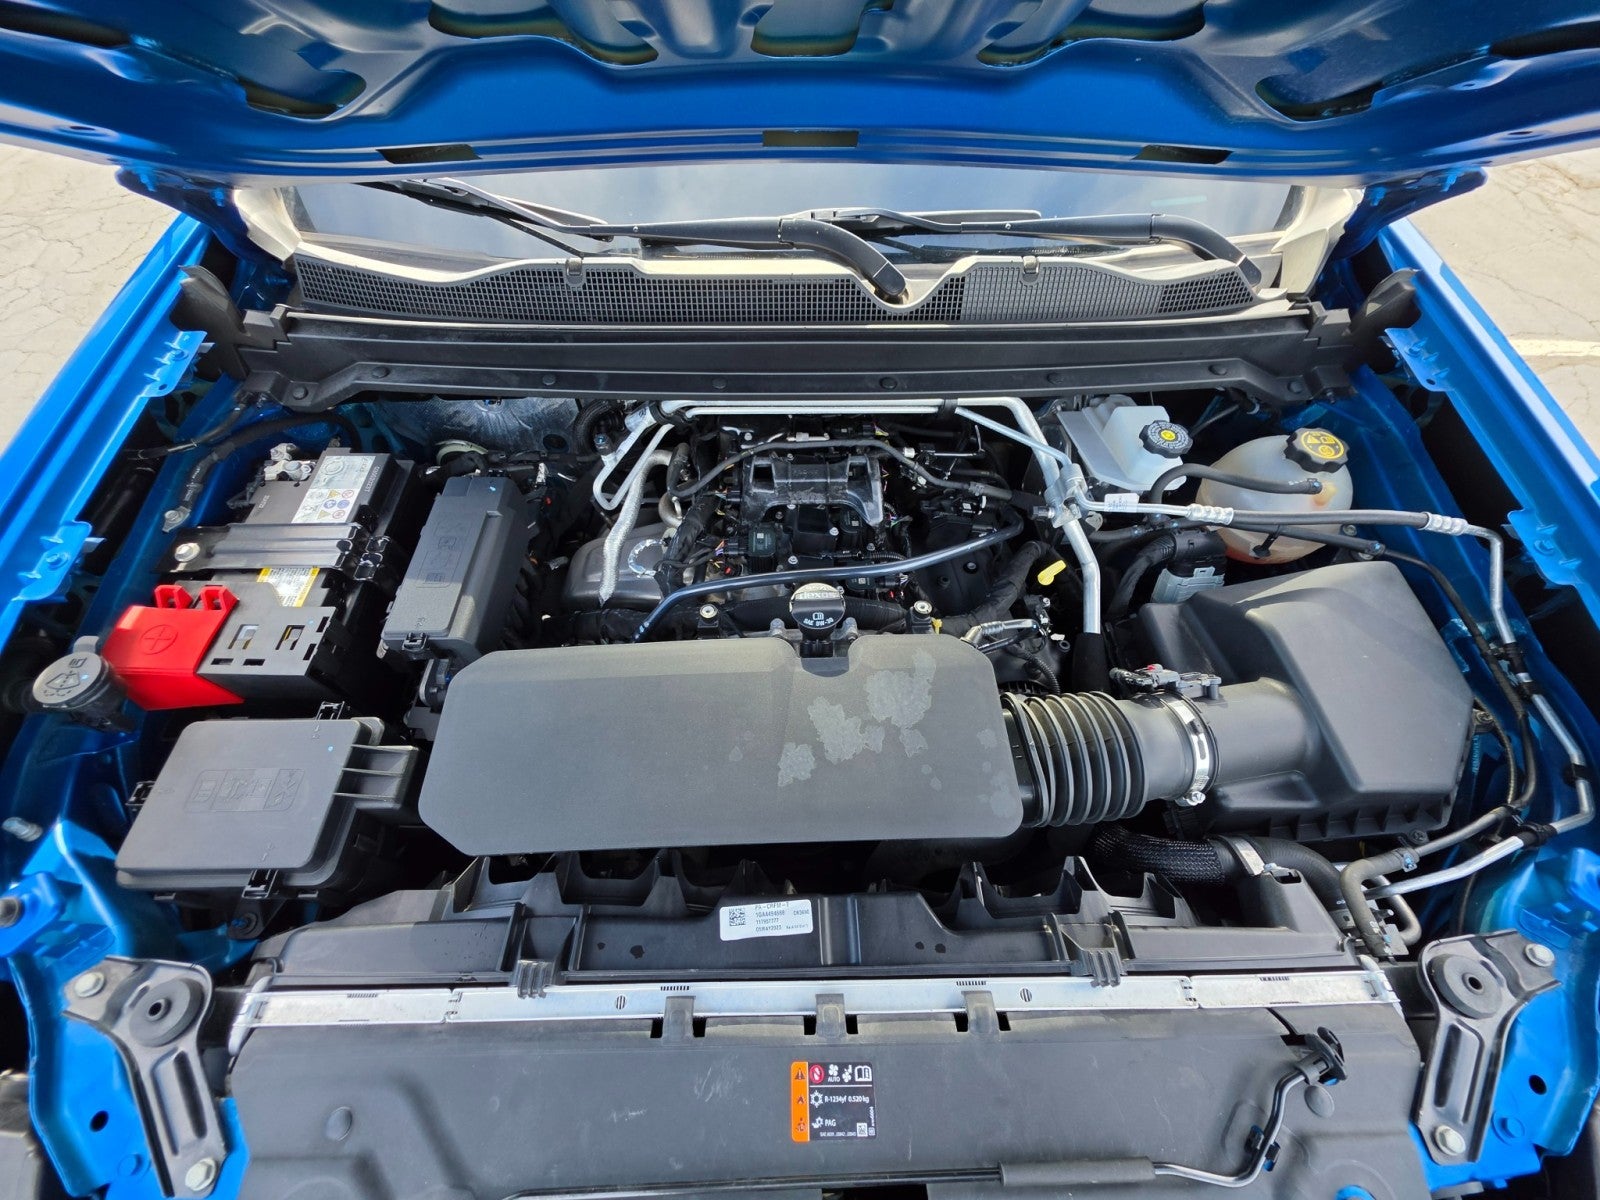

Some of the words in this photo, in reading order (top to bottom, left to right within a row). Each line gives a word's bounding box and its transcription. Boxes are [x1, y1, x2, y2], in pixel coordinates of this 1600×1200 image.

[803, 618, 815, 626] SAE
[824, 1095, 847, 1104] R-1234yf
[862, 1095, 870, 1104] kg
[824, 1119, 837, 1127] PAG
